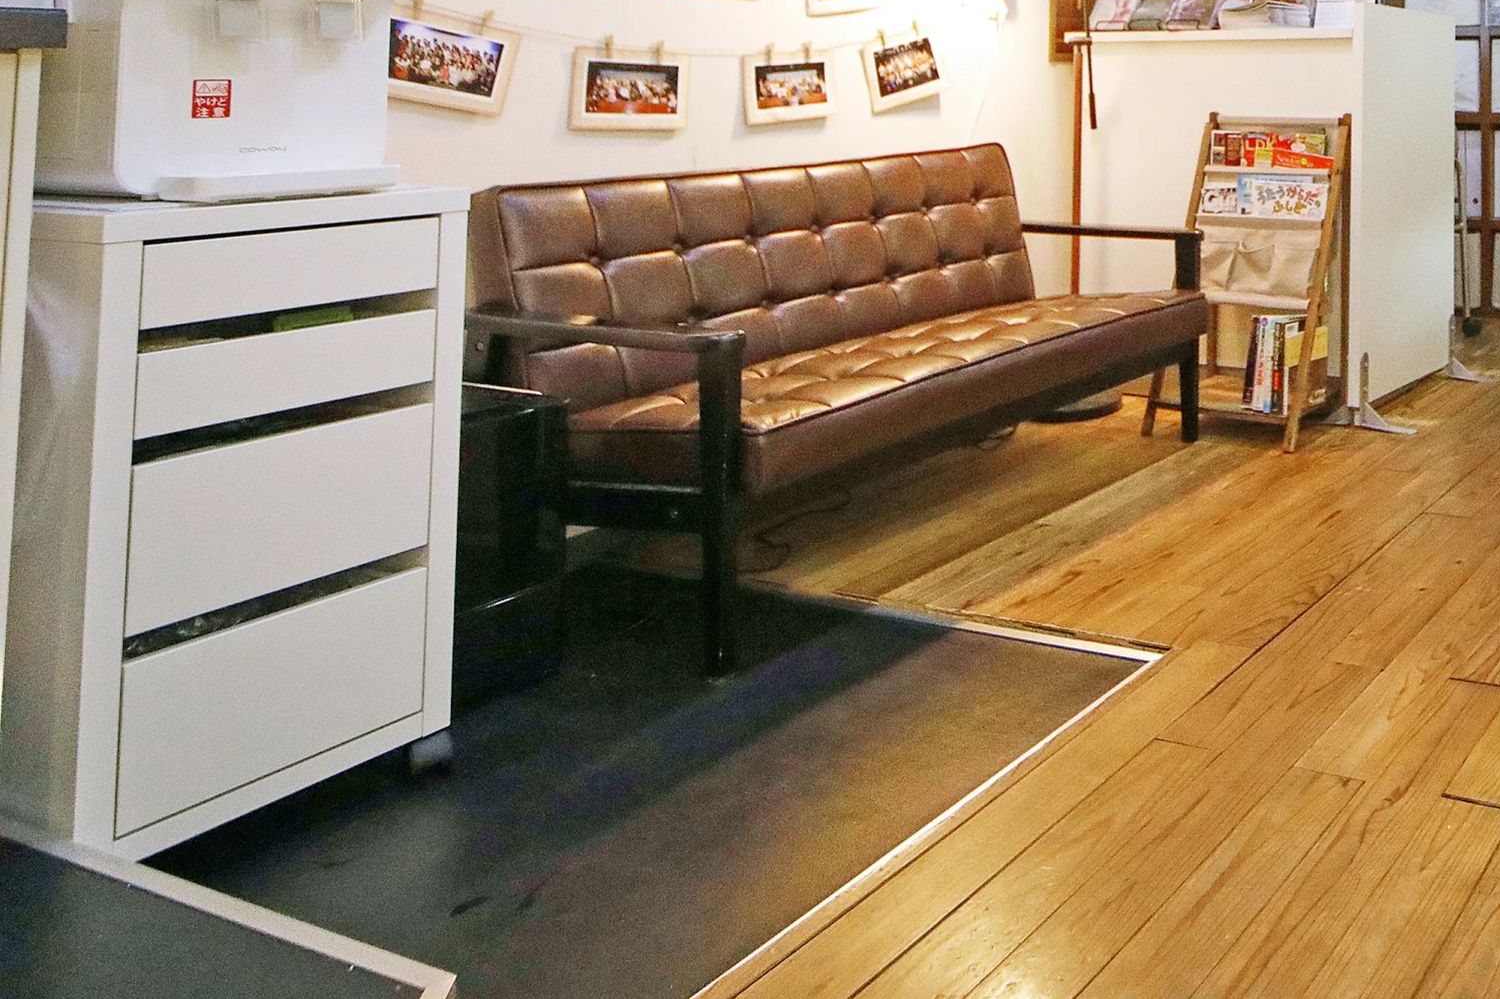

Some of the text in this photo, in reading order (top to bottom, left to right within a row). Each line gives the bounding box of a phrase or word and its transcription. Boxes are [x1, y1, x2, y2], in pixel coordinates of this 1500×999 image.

[194, 96, 228, 107] やけど
[195, 107, 226, 118] 注意
